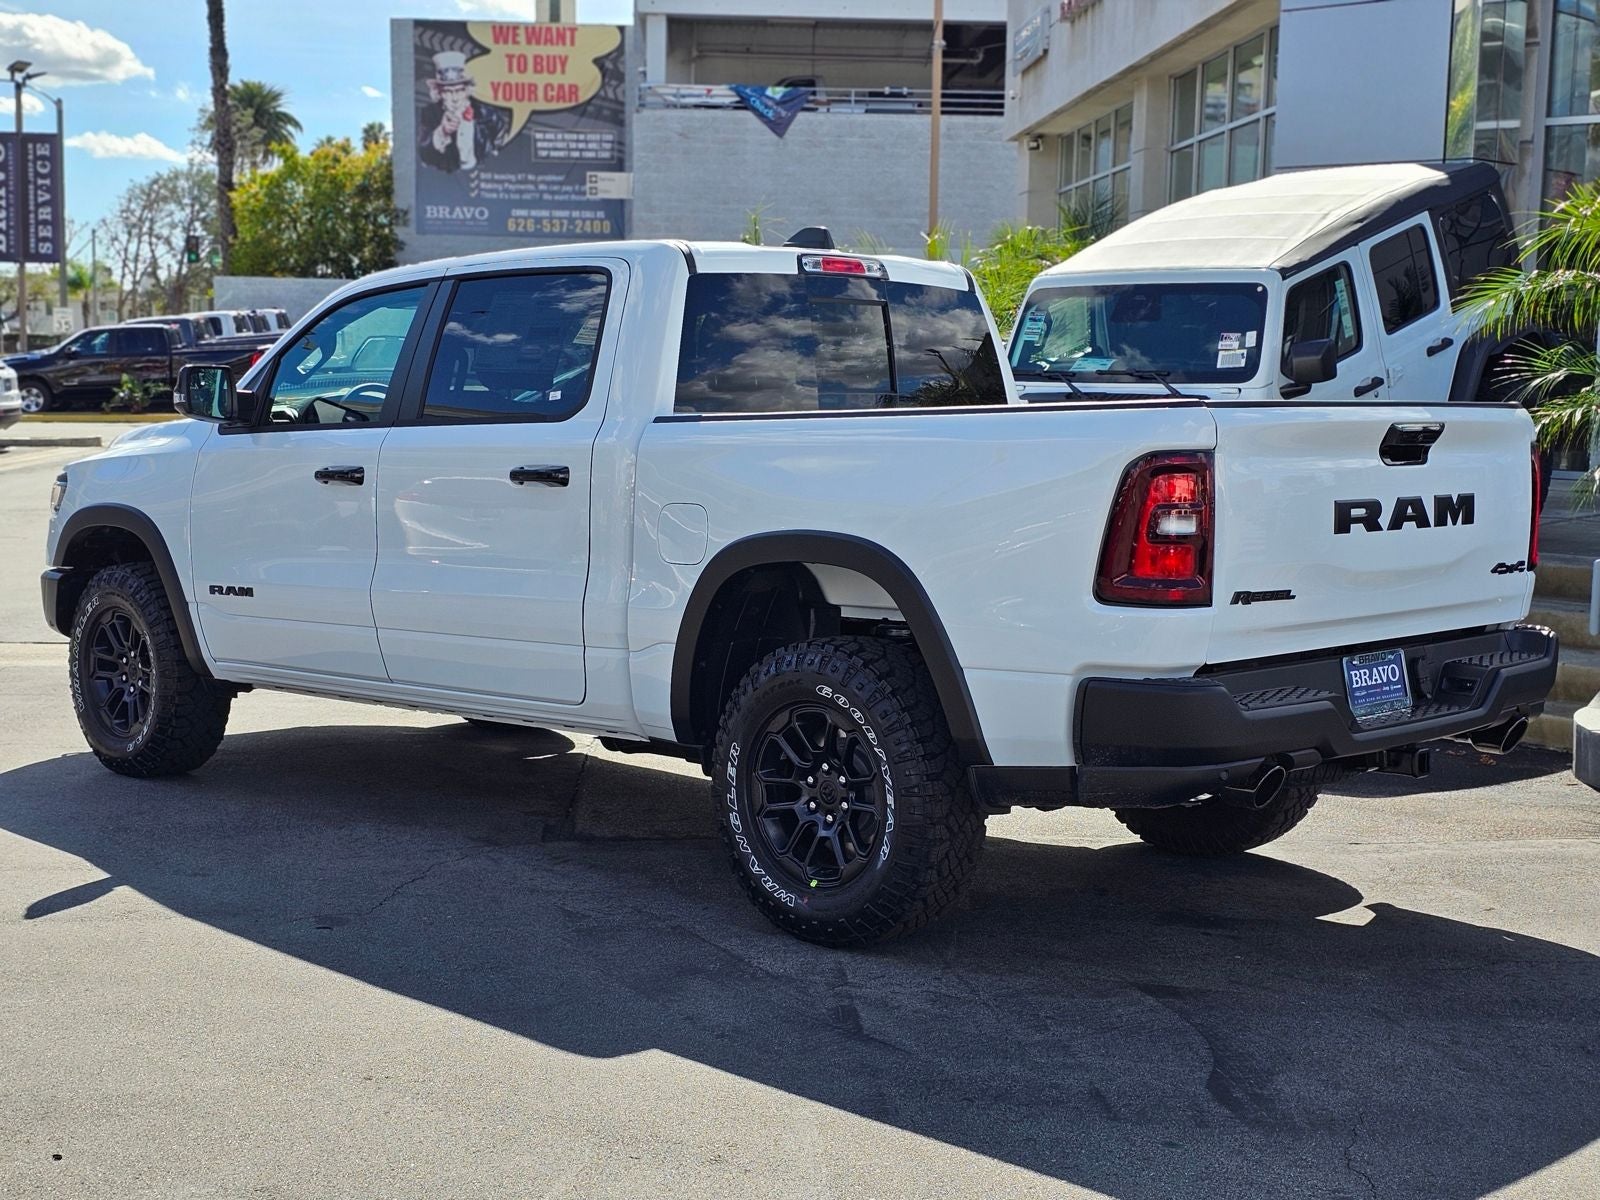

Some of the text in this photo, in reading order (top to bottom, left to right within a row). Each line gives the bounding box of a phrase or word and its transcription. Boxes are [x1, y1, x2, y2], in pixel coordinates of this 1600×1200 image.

[491, 24, 578, 47] WE WANT
[505, 53, 569, 75] TO BUY
[490, 81, 579, 103] YOUR CAR
[425, 205, 489, 220] BRAVO
[507, 217, 611, 234] 626-537-2400
[1334, 493, 1475, 535] RAM
[209, 584, 254, 597] RAM
[73, 595, 100, 713] WRANGLER
[1350, 664, 1400, 688] BRAVO
[816, 684, 895, 860] GOODYEAR
[727, 742, 795, 907] WRANGLER
